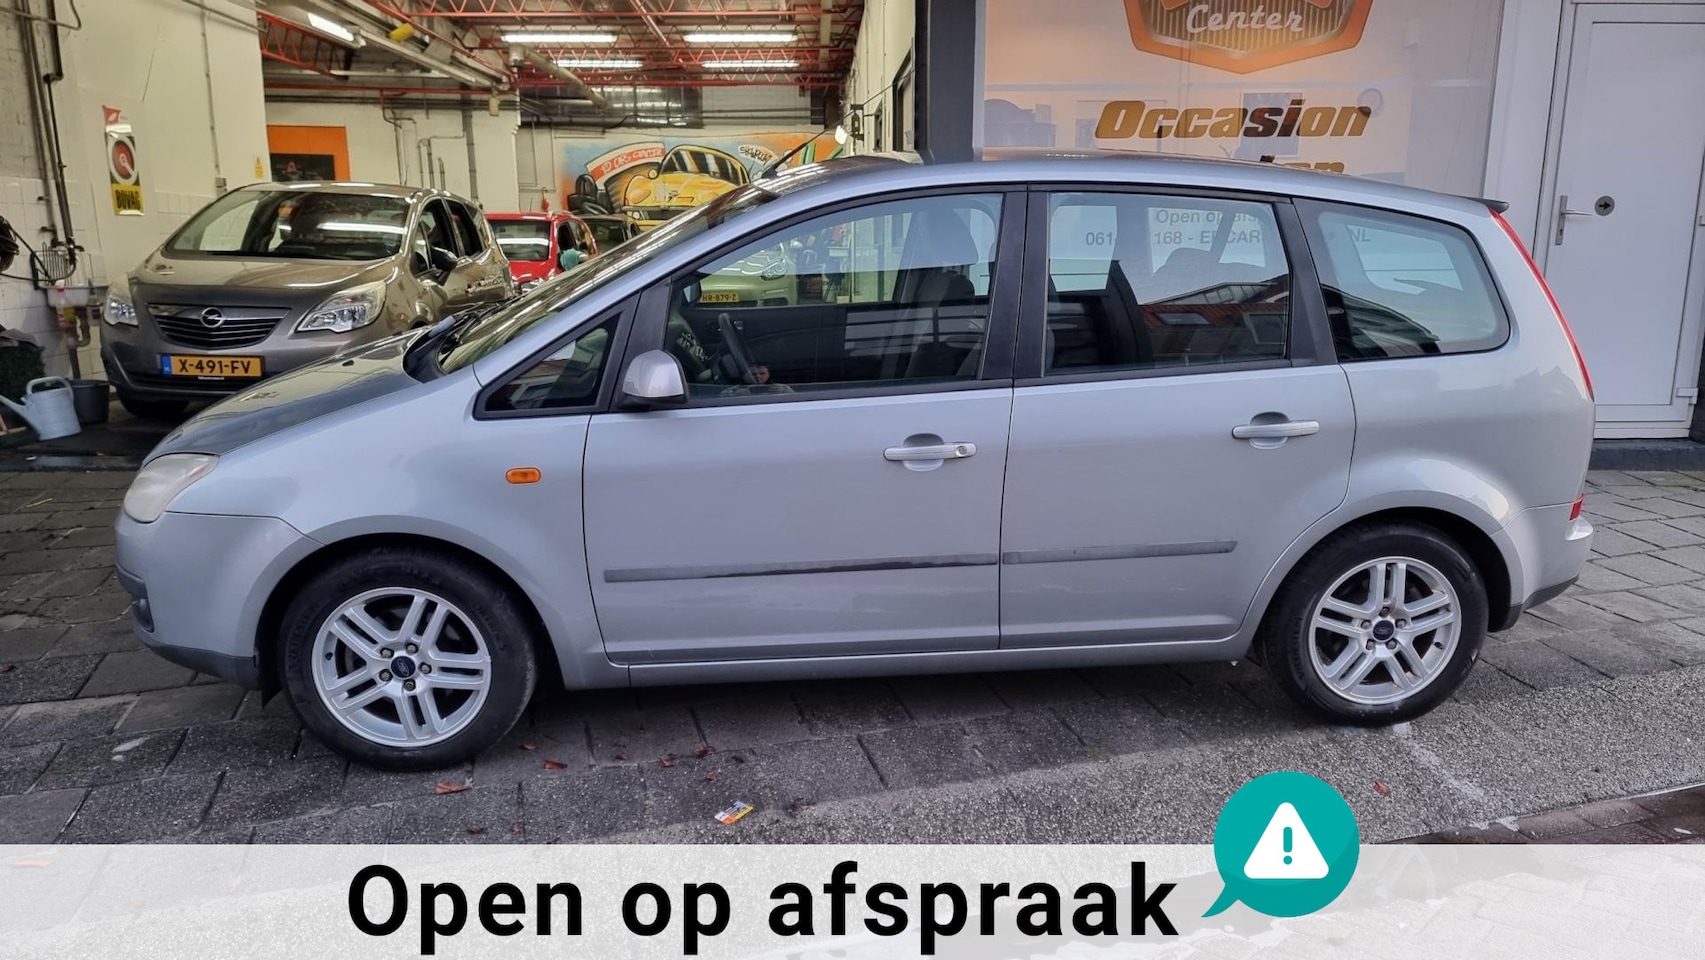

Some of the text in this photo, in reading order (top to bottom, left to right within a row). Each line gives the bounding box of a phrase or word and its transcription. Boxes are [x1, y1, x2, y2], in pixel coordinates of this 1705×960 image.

[1186, 4, 1304, 34] Center
[1095, 99, 1372, 139] Occasion
[1156, 209, 1200, 225] Open
[178, 358, 252, 374] X-491-FV
